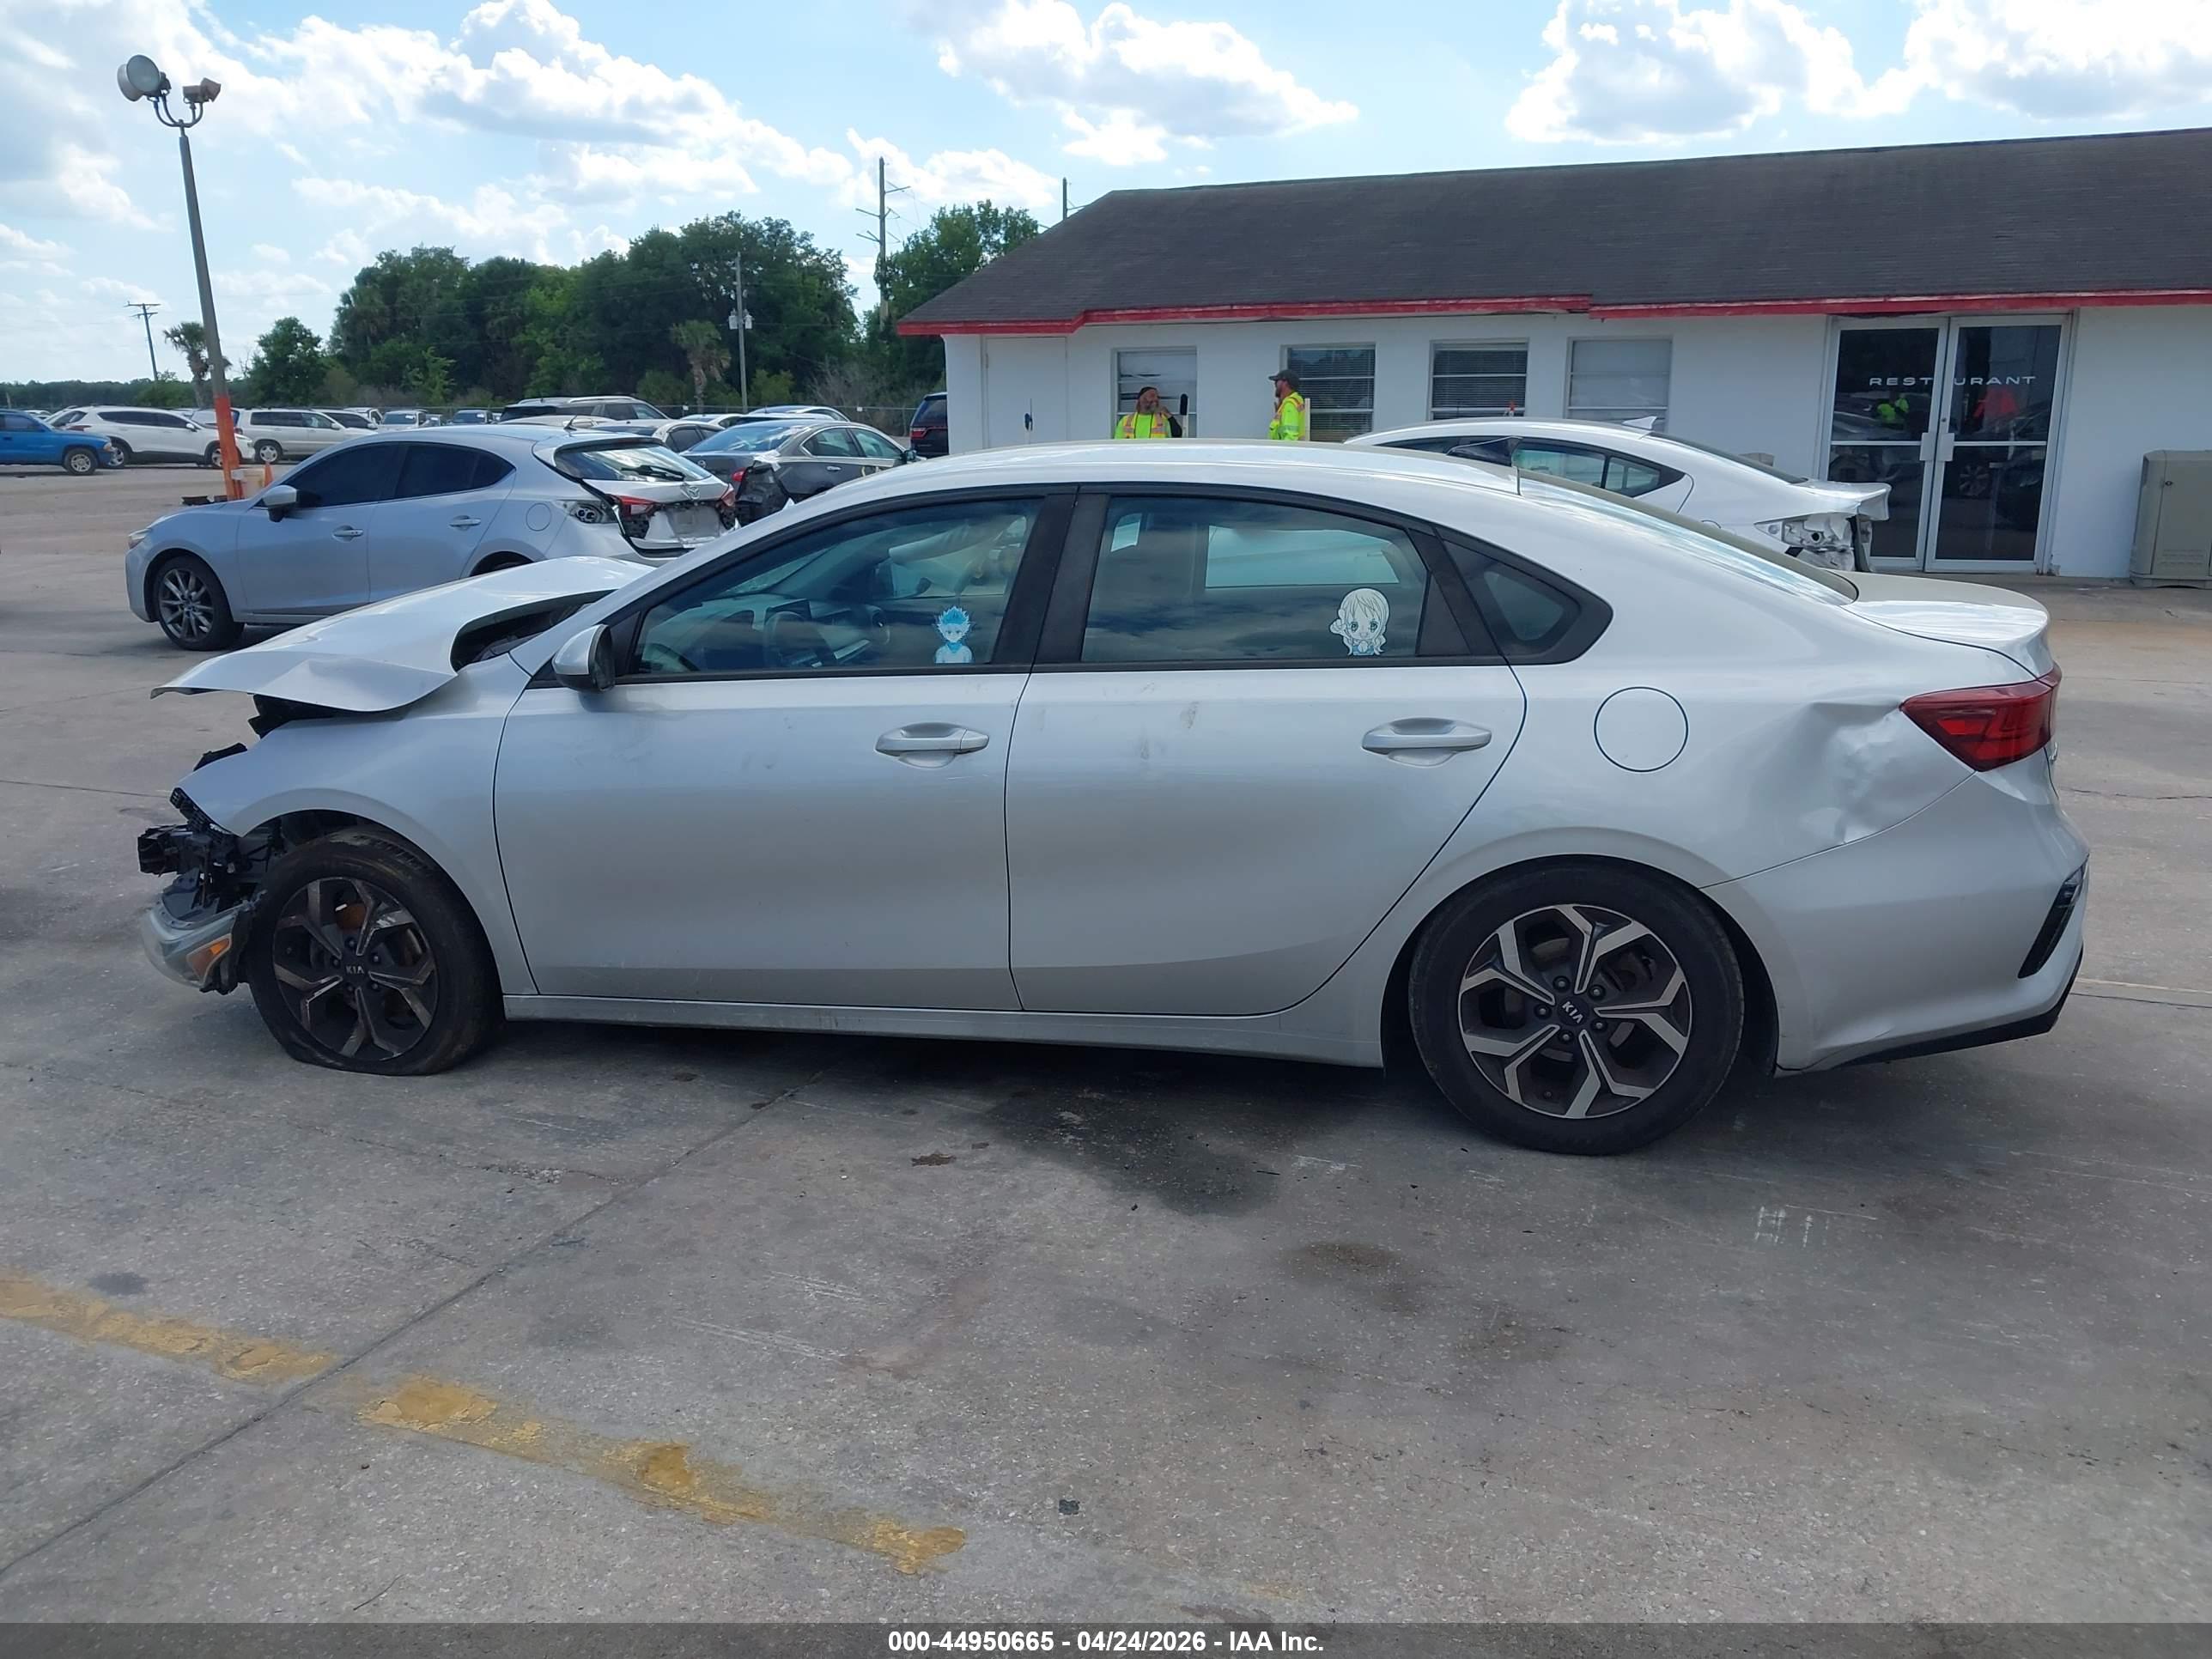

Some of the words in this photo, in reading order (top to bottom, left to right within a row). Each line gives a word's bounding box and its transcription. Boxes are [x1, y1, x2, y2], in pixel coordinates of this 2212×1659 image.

[1869, 375, 2036, 386] RESTURANT
[345, 965, 365, 975] KIA
[1561, 1000, 1584, 1024] KIA
